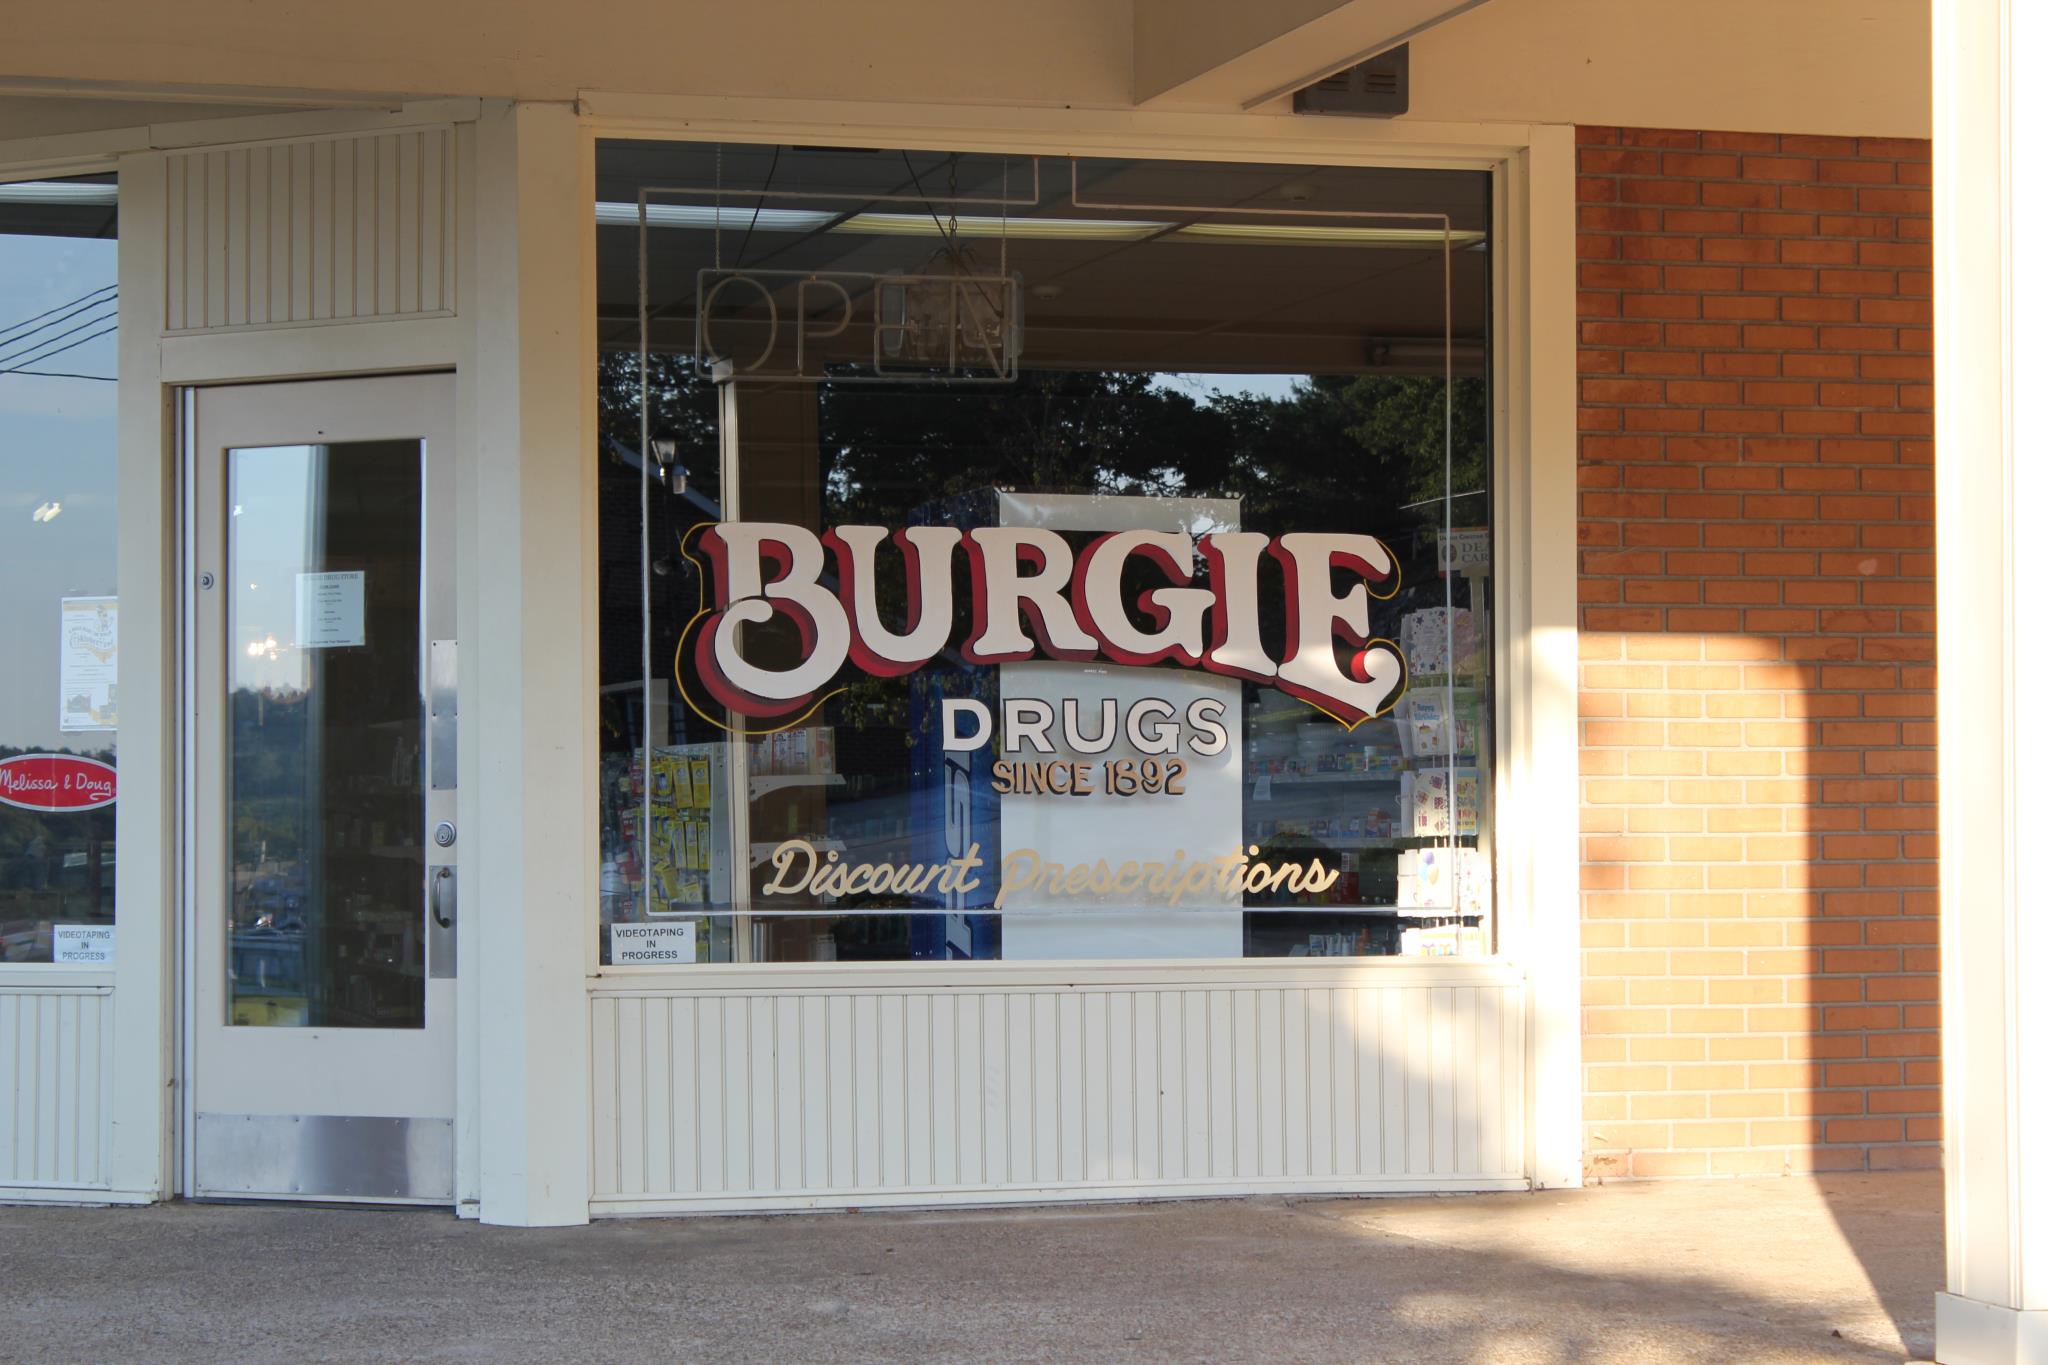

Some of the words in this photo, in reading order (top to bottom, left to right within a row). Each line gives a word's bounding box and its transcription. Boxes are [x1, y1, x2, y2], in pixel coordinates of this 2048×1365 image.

[702, 275, 1009, 380] OPEN
[694, 521, 1402, 720] BURGIE
[942, 698, 1229, 757] DRUGS
[0, 768, 58, 794] Melissa
[76, 772, 112, 801] Doug
[991, 759, 1096, 797] SINCE
[1104, 758, 1188, 797] 1892
[762, 839, 983, 896] Discount
[994, 844, 1339, 909] Prescriptions
[58, 930, 111, 939] VIDEOTAPING
[616, 928, 684, 938] VIDEOTAPING
[81, 941, 89, 950] IN
[621, 950, 678, 960] PROGRESS
[646, 940, 656, 949] IN
[62, 951, 105, 961] PROGRESS
